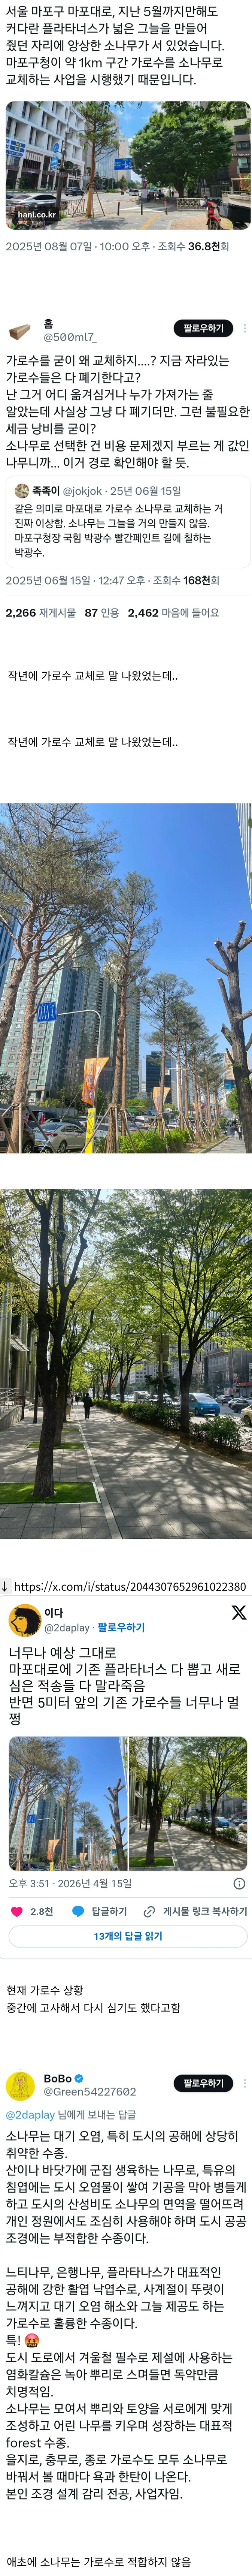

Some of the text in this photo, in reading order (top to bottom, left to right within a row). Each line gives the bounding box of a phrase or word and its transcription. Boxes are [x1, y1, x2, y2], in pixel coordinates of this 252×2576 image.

[6, 6, 218, 19] 서울 마포구 마포대로, 지난 5월까지만해도
[6, 57, 223, 69] 마포구청이 약 1km 구간 가로수를 소나무로
[6, 241, 229, 252] 2025년 08월 07일 10:00 오후 조회수 36.8천회
[43, 319, 53, 329] 홈
[183, 324, 224, 333] 팔로우하기
[44, 332, 97, 343] @500ml7_
[6, 372, 141, 384] 가로수들은 다 폐기한다고?
[6, 457, 189, 469] 나무니까... 이거 경로 확인해야 할 듯.
[32, 486, 181, 498] 족족이 @jokjok 25년 06월 15일
[15, 533, 212, 543] 마포구청장 국힘 박광수 빨간페인트 길에 칠하는
[15, 548, 45, 558] 박광수.
[6, 575, 219, 586] 2025년 06월 15일 12:47 오후 조회수 168천회
[6, 608, 219, 619] 2,266 재게시물 87 인용 2,462 마음에 들어요
[45, 1608, 64, 1618] 이다
[45, 1622, 145, 1634] @2daplay 팔로우하기
[9, 1663, 241, 1676] 마포대로에 기존 플라타너스 다 뽑고 새로
[9, 1712, 20, 1726] 쩡
[9, 1878, 131, 1888] 오후 3:51 2026년 4월 15일
[31, 1906, 53, 1916] 2.8천
[92, 1906, 127, 1916] 답글하기
[163, 1906, 247, 1916] 게시물 링크 복사하기
[94, 1931, 162, 1941] 13개의 답글 읽기
[44, 2074, 72, 2083] BoBo
[183, 2079, 224, 2088] 팔로우하기
[44, 2087, 136, 2096] @Green54227602
[6, 2110, 136, 2121] @2daplay 님에게 보내는 답글
[6, 2130, 237, 2144] 소나무는 대기 오염, 특히 도시의 공해에 상당히
[6, 2232, 149, 2245] 조경에는 부적합한 수종이다.
[6, 2301, 225, 2313] 느껴지고 대기 오염 해소와 그늘 제공도 하는
[6, 2335, 20, 2347] 특!
[6, 2420, 232, 2432] 조성하고 어린 나무를 키우며 성장하는 대표적
[6, 2437, 69, 2449] forest 수종.
[6, 2488, 182, 2501] 본인 조경 설계 감리 전공, 사업자임.
